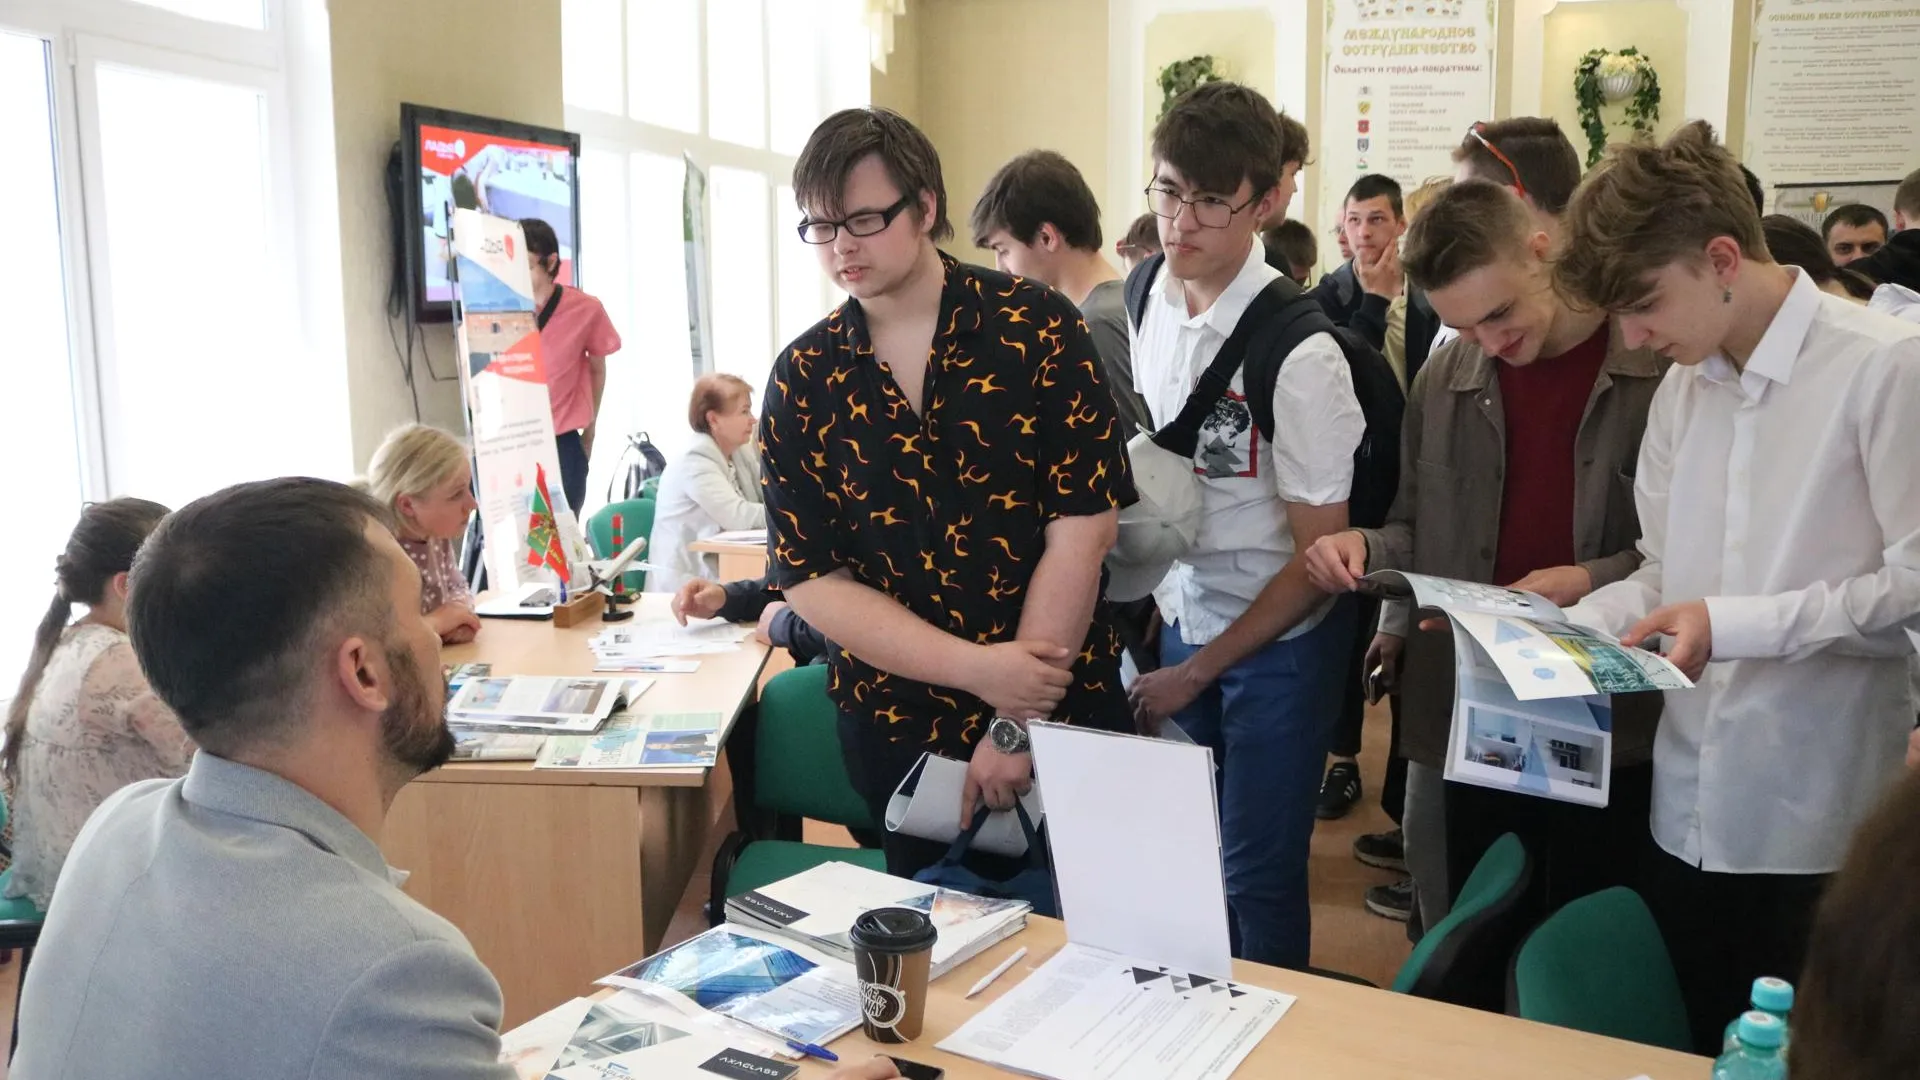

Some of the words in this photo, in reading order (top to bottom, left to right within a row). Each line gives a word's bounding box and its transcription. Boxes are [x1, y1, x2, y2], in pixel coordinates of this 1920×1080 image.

[1343, 26, 1477, 41] МЕЖДУНАРОДНОЕ
[1342, 42, 1477, 58] СОТРУДНИЧЕСТВО
[1333, 63, 1376, 74] Области
[719, 1056, 779, 1077] AXAGLASS
